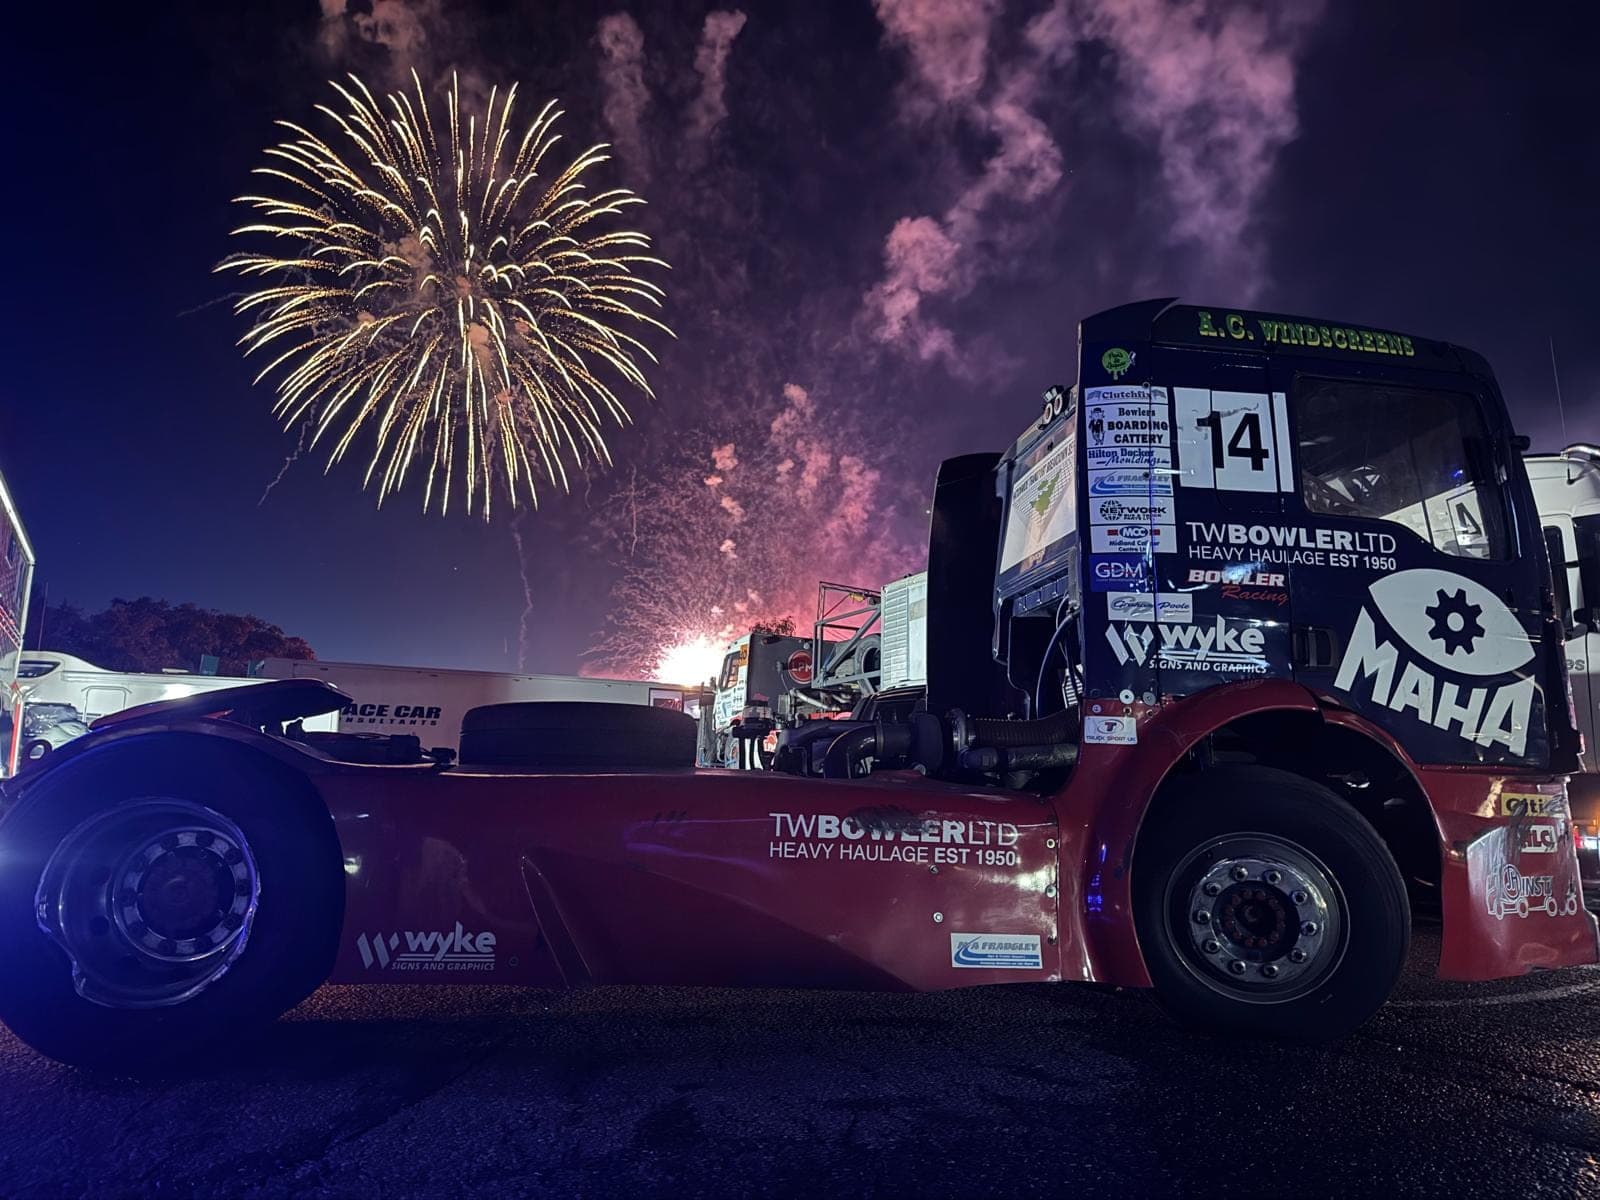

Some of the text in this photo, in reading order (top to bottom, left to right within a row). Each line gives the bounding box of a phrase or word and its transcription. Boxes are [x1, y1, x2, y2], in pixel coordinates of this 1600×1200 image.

[1258, 319, 1415, 357] WINDSCREENS
[1107, 420, 1168, 431] BOARDING
[1114, 433, 1163, 444] CATTERY
[1196, 410, 1269, 472] 14
[1088, 449, 1118, 459] Hilton
[1099, 506, 1167, 514] NETWORK
[1122, 527, 1146, 537] MCC
[1188, 545, 1397, 571] HEAVY HAULAGE EST 1950
[1095, 562, 1143, 579] GDM
[1188, 569, 1286, 587] BOWLER
[1220, 584, 1289, 606] Racing
[1157, 614, 1265, 661] wyke
[1149, 658, 1268, 674] SIGNS AND GRAPHICS
[1333, 605, 1536, 757] MAHA
[341, 703, 442, 719] ACE CAR
[345, 717, 438, 726] NSULTANTS
[769, 841, 1017, 866] HEAVY HAULAGE EST 1950
[404, 920, 497, 962] wyke
[391, 961, 496, 971] SIGNS AND GRAPHICS
